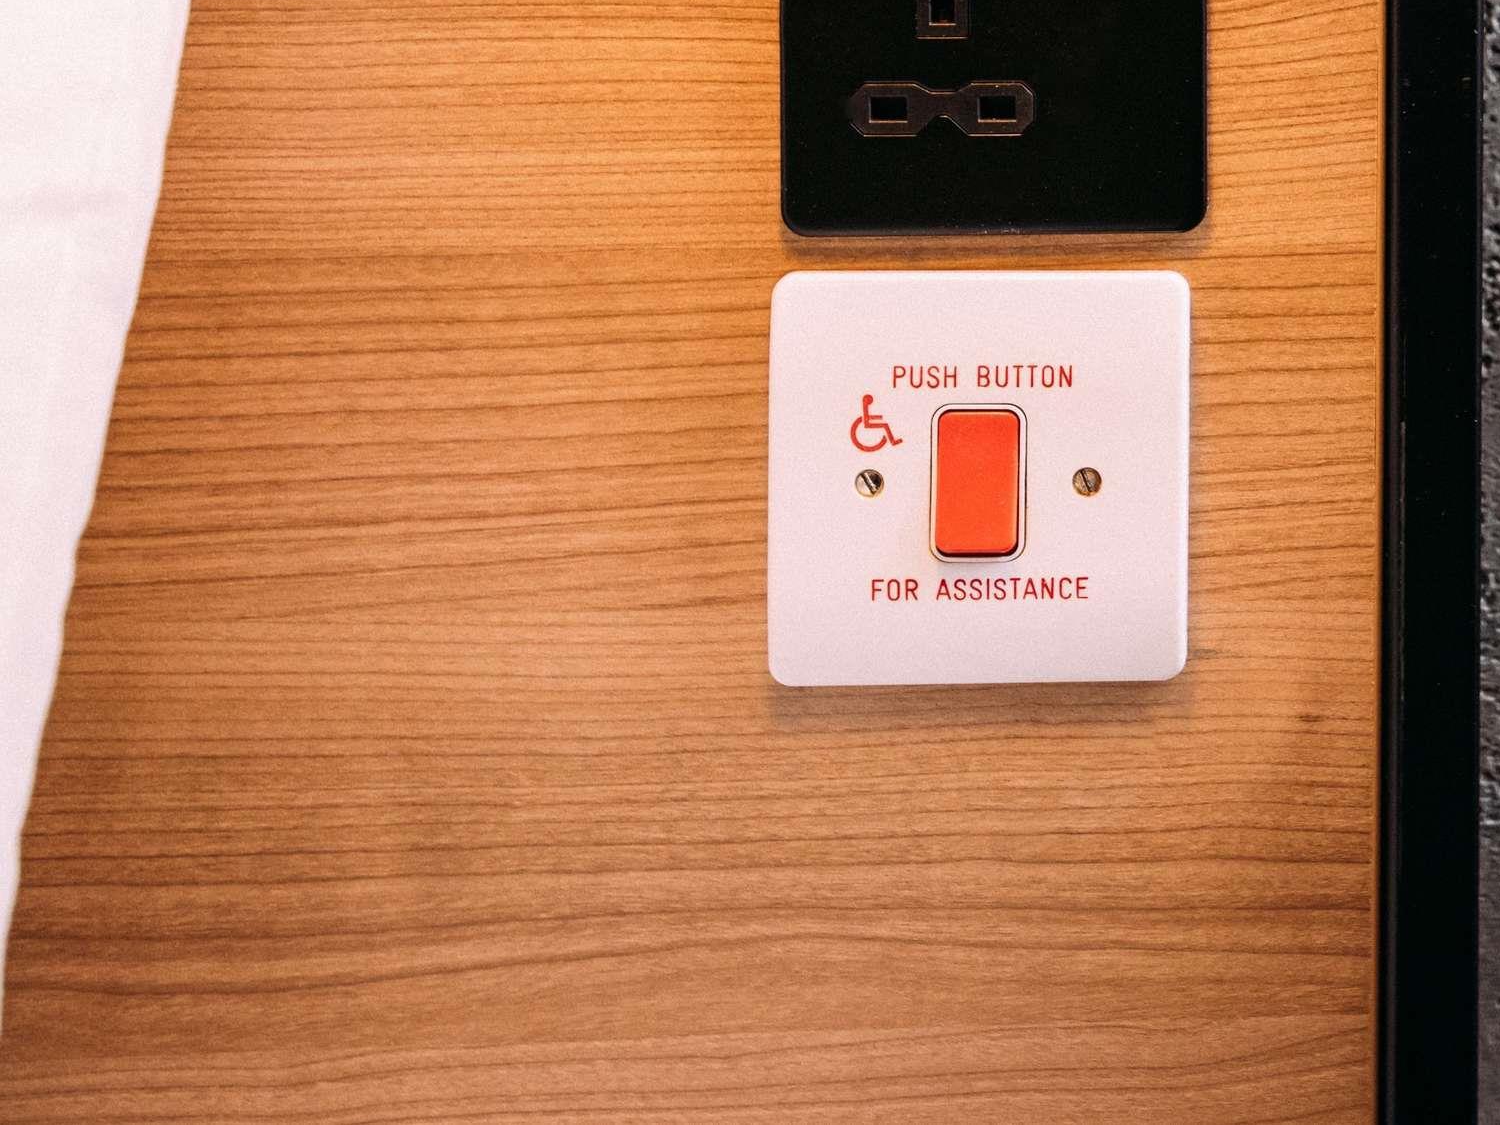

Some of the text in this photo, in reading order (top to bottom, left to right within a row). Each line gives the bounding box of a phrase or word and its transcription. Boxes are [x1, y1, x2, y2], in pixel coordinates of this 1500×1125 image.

[892, 364, 1074, 388] PUSH BUTTON
[871, 577, 1090, 601] FOR ASSISTANCE
